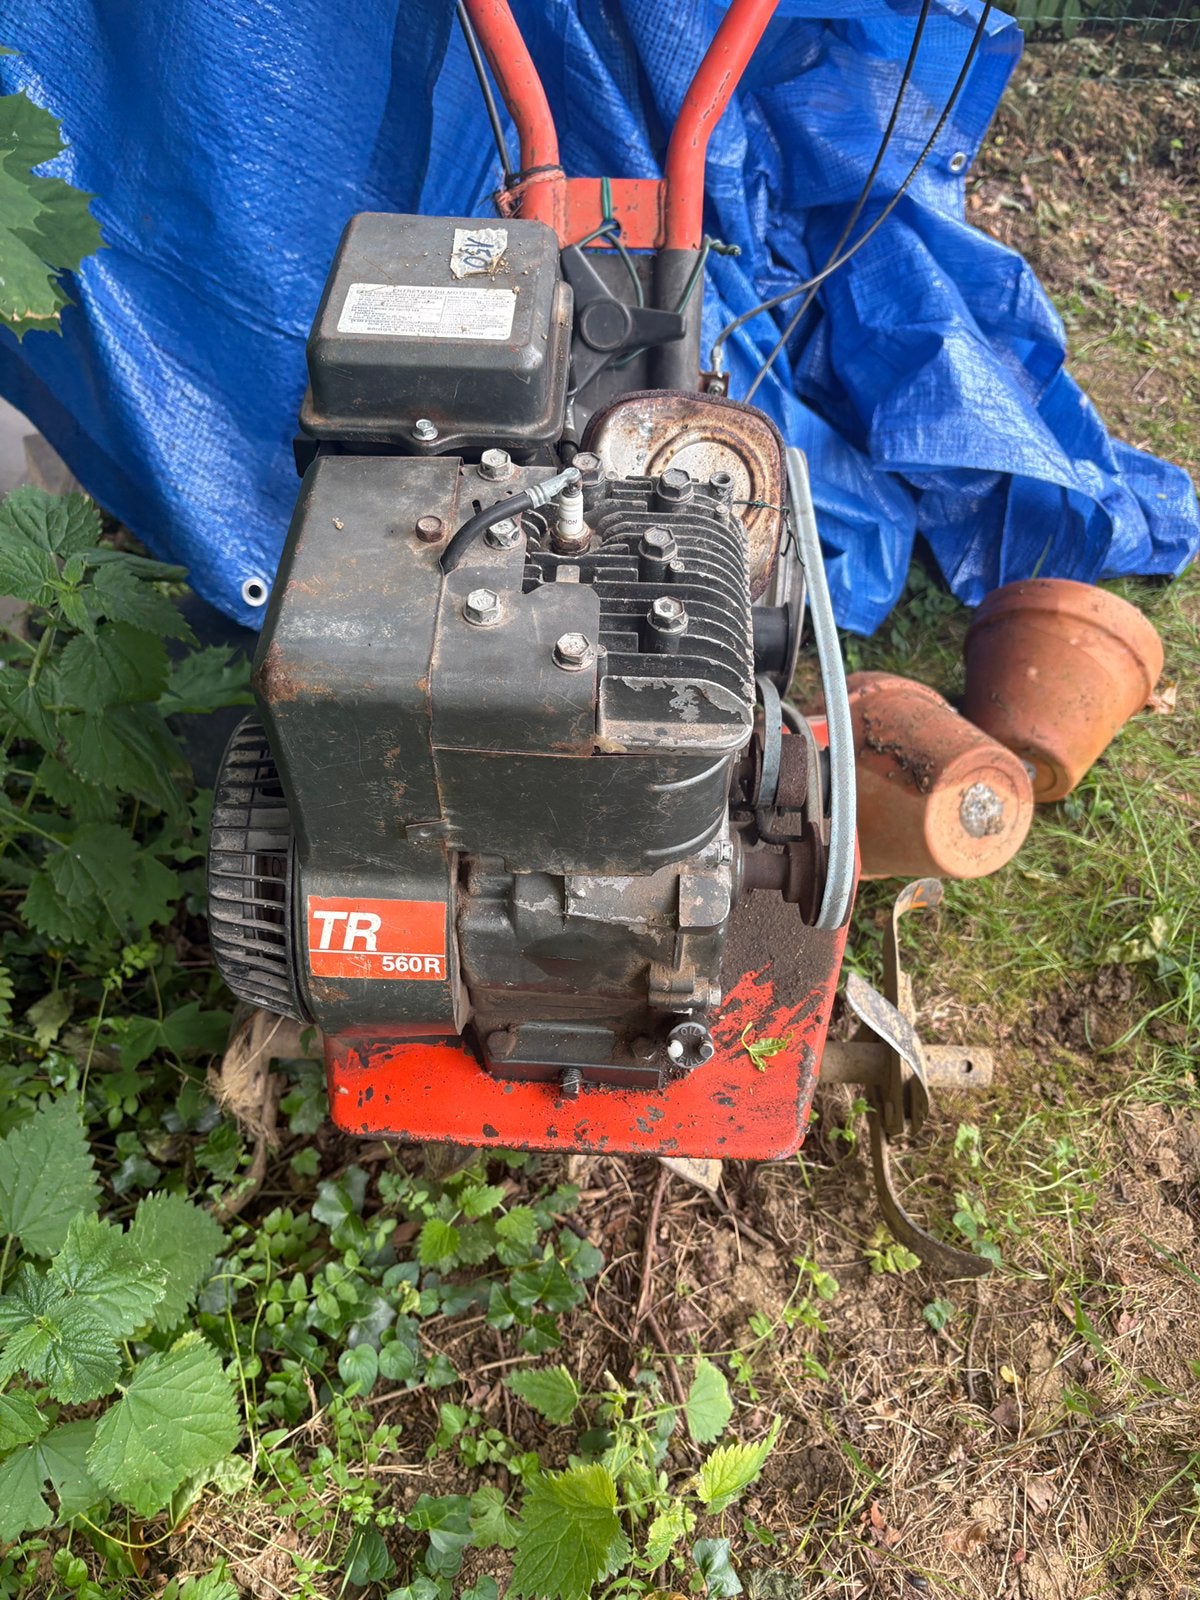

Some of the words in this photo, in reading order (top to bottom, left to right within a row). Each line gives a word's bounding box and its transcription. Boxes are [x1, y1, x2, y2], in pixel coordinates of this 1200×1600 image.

[313, 910, 382, 952] TR
[382, 955, 441, 974] 560R
[680, 1026, 701, 1037] OIL
[677, 1055, 705, 1068] FILL
